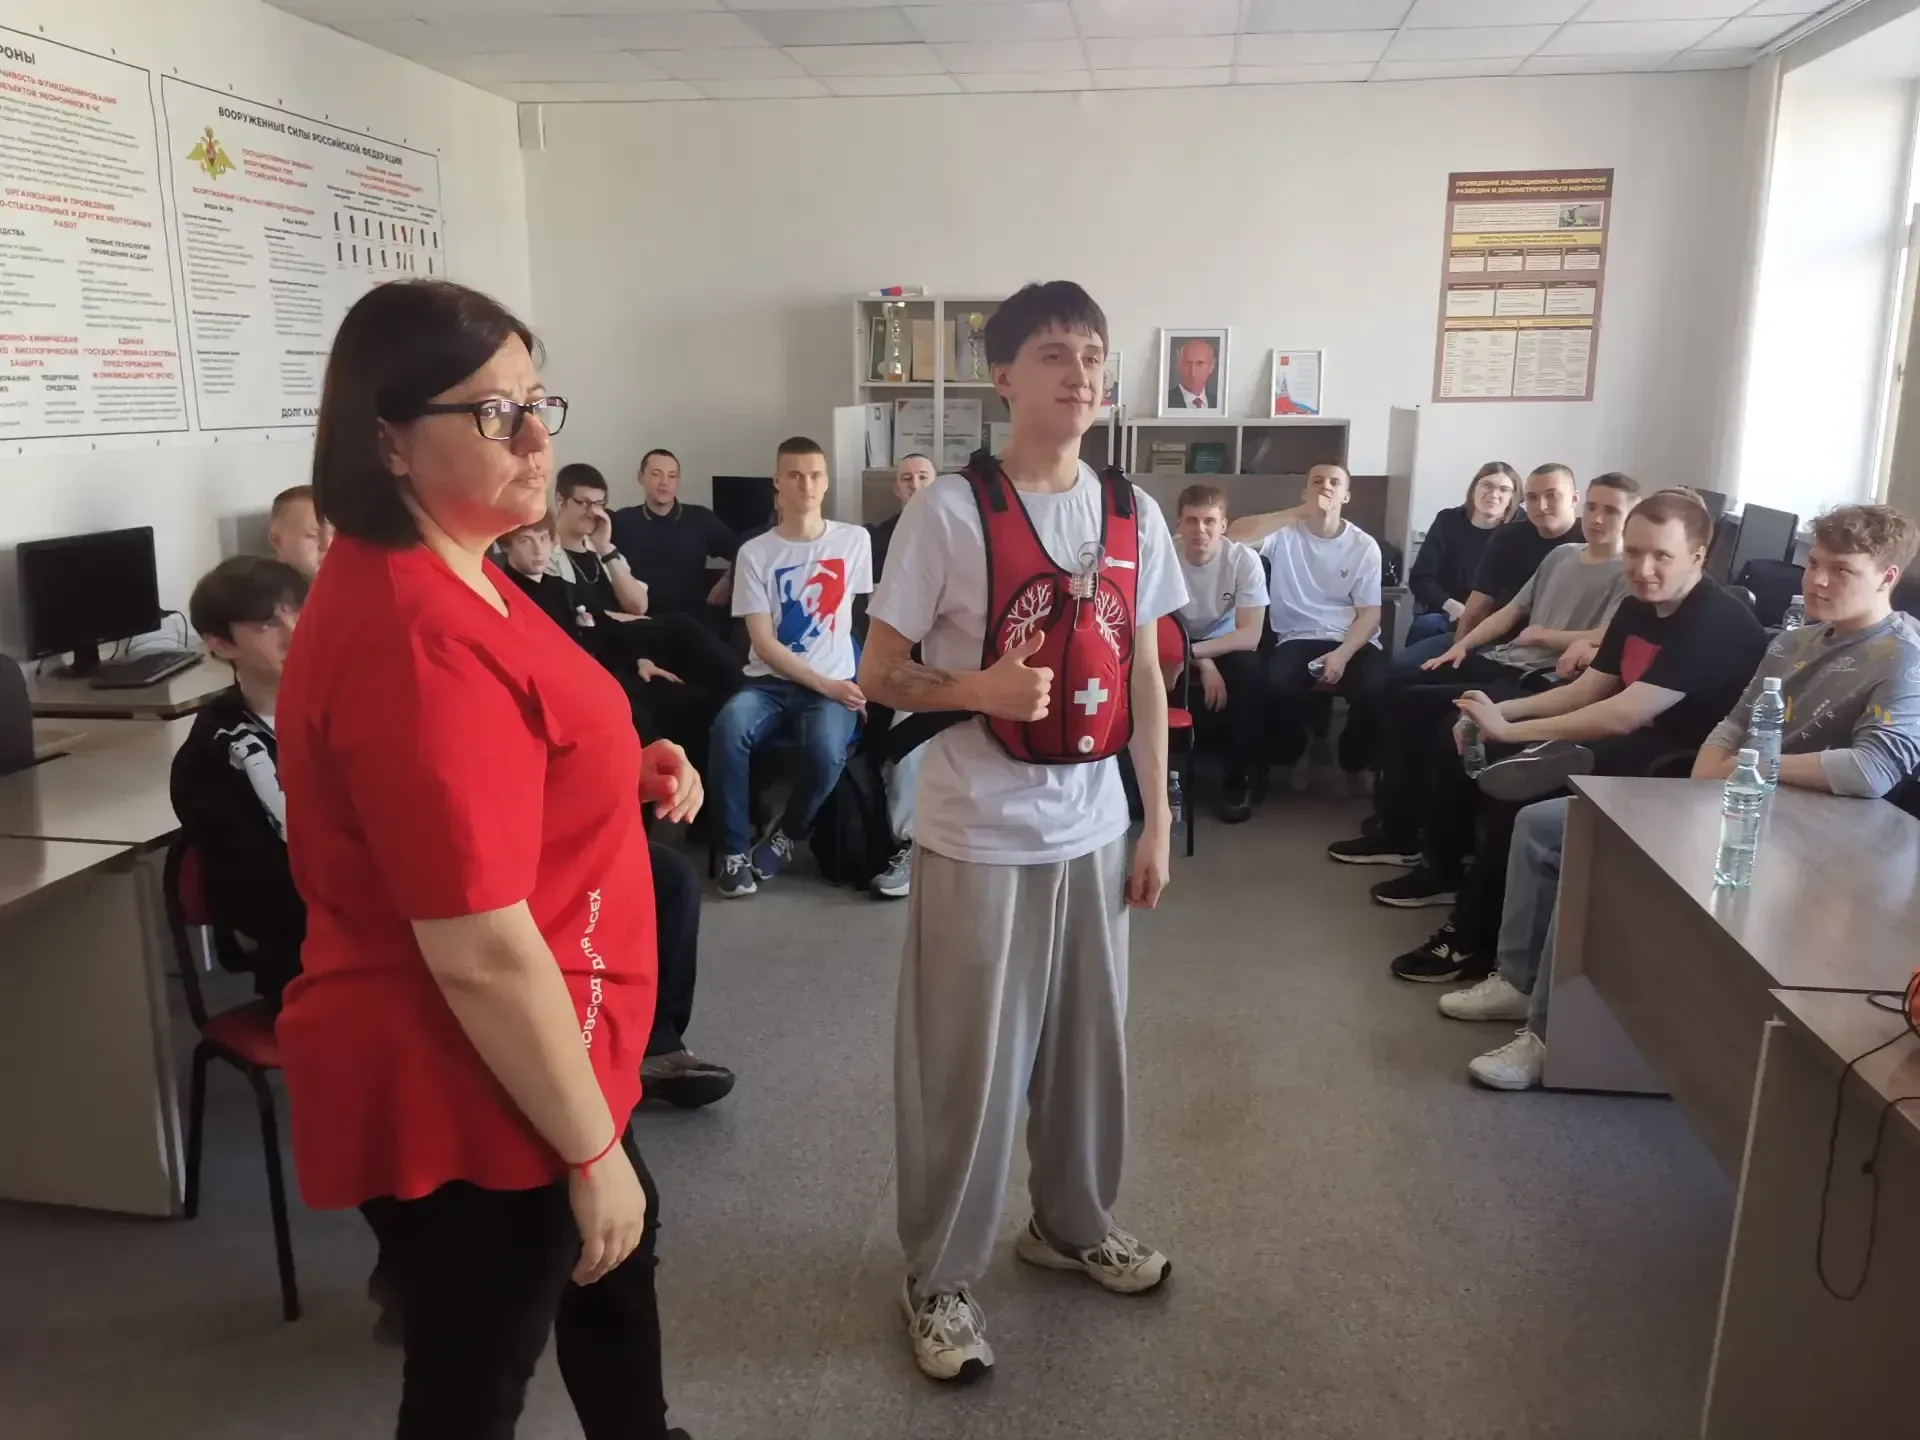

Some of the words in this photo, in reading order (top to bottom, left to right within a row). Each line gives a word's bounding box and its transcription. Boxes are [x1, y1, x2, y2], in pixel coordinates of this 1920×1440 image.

[218, 106, 286, 134] ВООРУЖЕННЫЕ
[287, 125, 311, 141] СИЛЫ
[311, 132, 361, 155] РОССИЙСКОЙ
[362, 146, 403, 166] ФЕДЕРАЦИИ
[53, 219, 77, 229] РАБОТ
[281, 408, 301, 419] ДОЛГ
[584, 888, 602, 934] ВСЕХ
[581, 937, 606, 970] ДЛЯ
